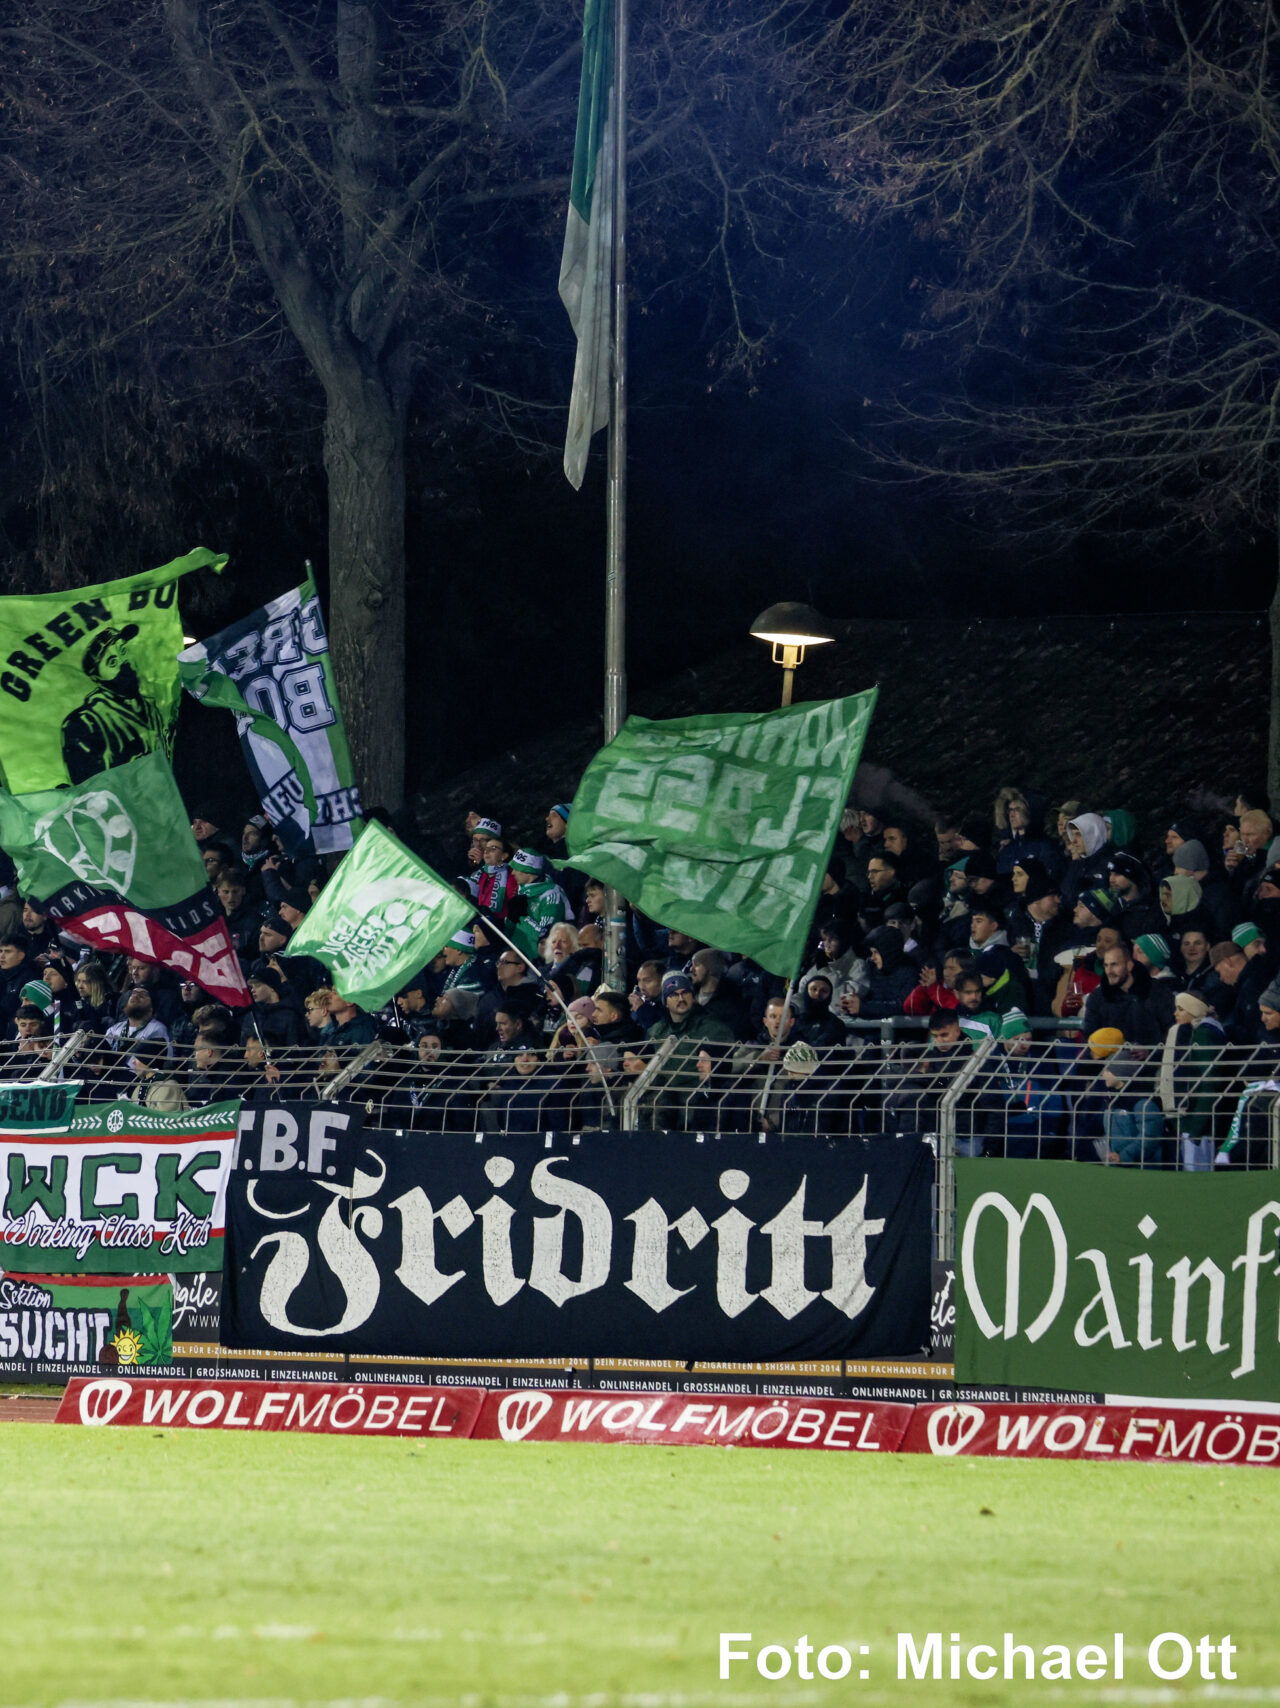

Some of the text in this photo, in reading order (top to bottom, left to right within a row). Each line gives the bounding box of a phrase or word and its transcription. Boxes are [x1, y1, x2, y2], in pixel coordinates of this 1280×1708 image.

[0, 597, 112, 702] GREEN
[3, 1151, 221, 1221] WCK
[4, 1209, 213, 1260] Working Class Kids
[246, 1148, 886, 1337] Fridritt
[961, 1191, 1280, 1380] Mainf
[37, 1363, 102, 1374] EINZELHANDEL
[118, 1365, 339, 1381] ONLINEHANDEL GROSSHANDEL EINZELHANDEL
[568, 1357, 588, 1367] 2014
[595, 1358, 615, 1367] DEIN
[618, 1358, 669, 1369] FACHHANDEL
[694, 1361, 753, 1372] E-ZIGARETTEN
[756, 1364, 762, 1372] &
[765, 1363, 796, 1373] SHISHA
[799, 1364, 818, 1374] SEIT
[820, 1365, 840, 1374] 2014
[847, 1365, 867, 1374] DEIN
[871, 1365, 927, 1375] FACHHANDEL
[931, 1366, 947, 1376] FÜR
[355, 1373, 425, 1385] ONLINEHANDEL
[436, 1375, 502, 1387] GROSSHANDEL
[600, 1380, 835, 1397] ONLINEHANDEL GROSSHANDEL EINZELHANDEL
[852, 1387, 928, 1399] ONLINEHANDEL
[1022, 1391, 1097, 1404] EINZELHANDEL
[142, 1387, 454, 1432] WOLFMÖBEL
[560, 1399, 880, 1450] WOLFMÖBEL
[996, 1414, 1280, 1462] WOLFMÖB
